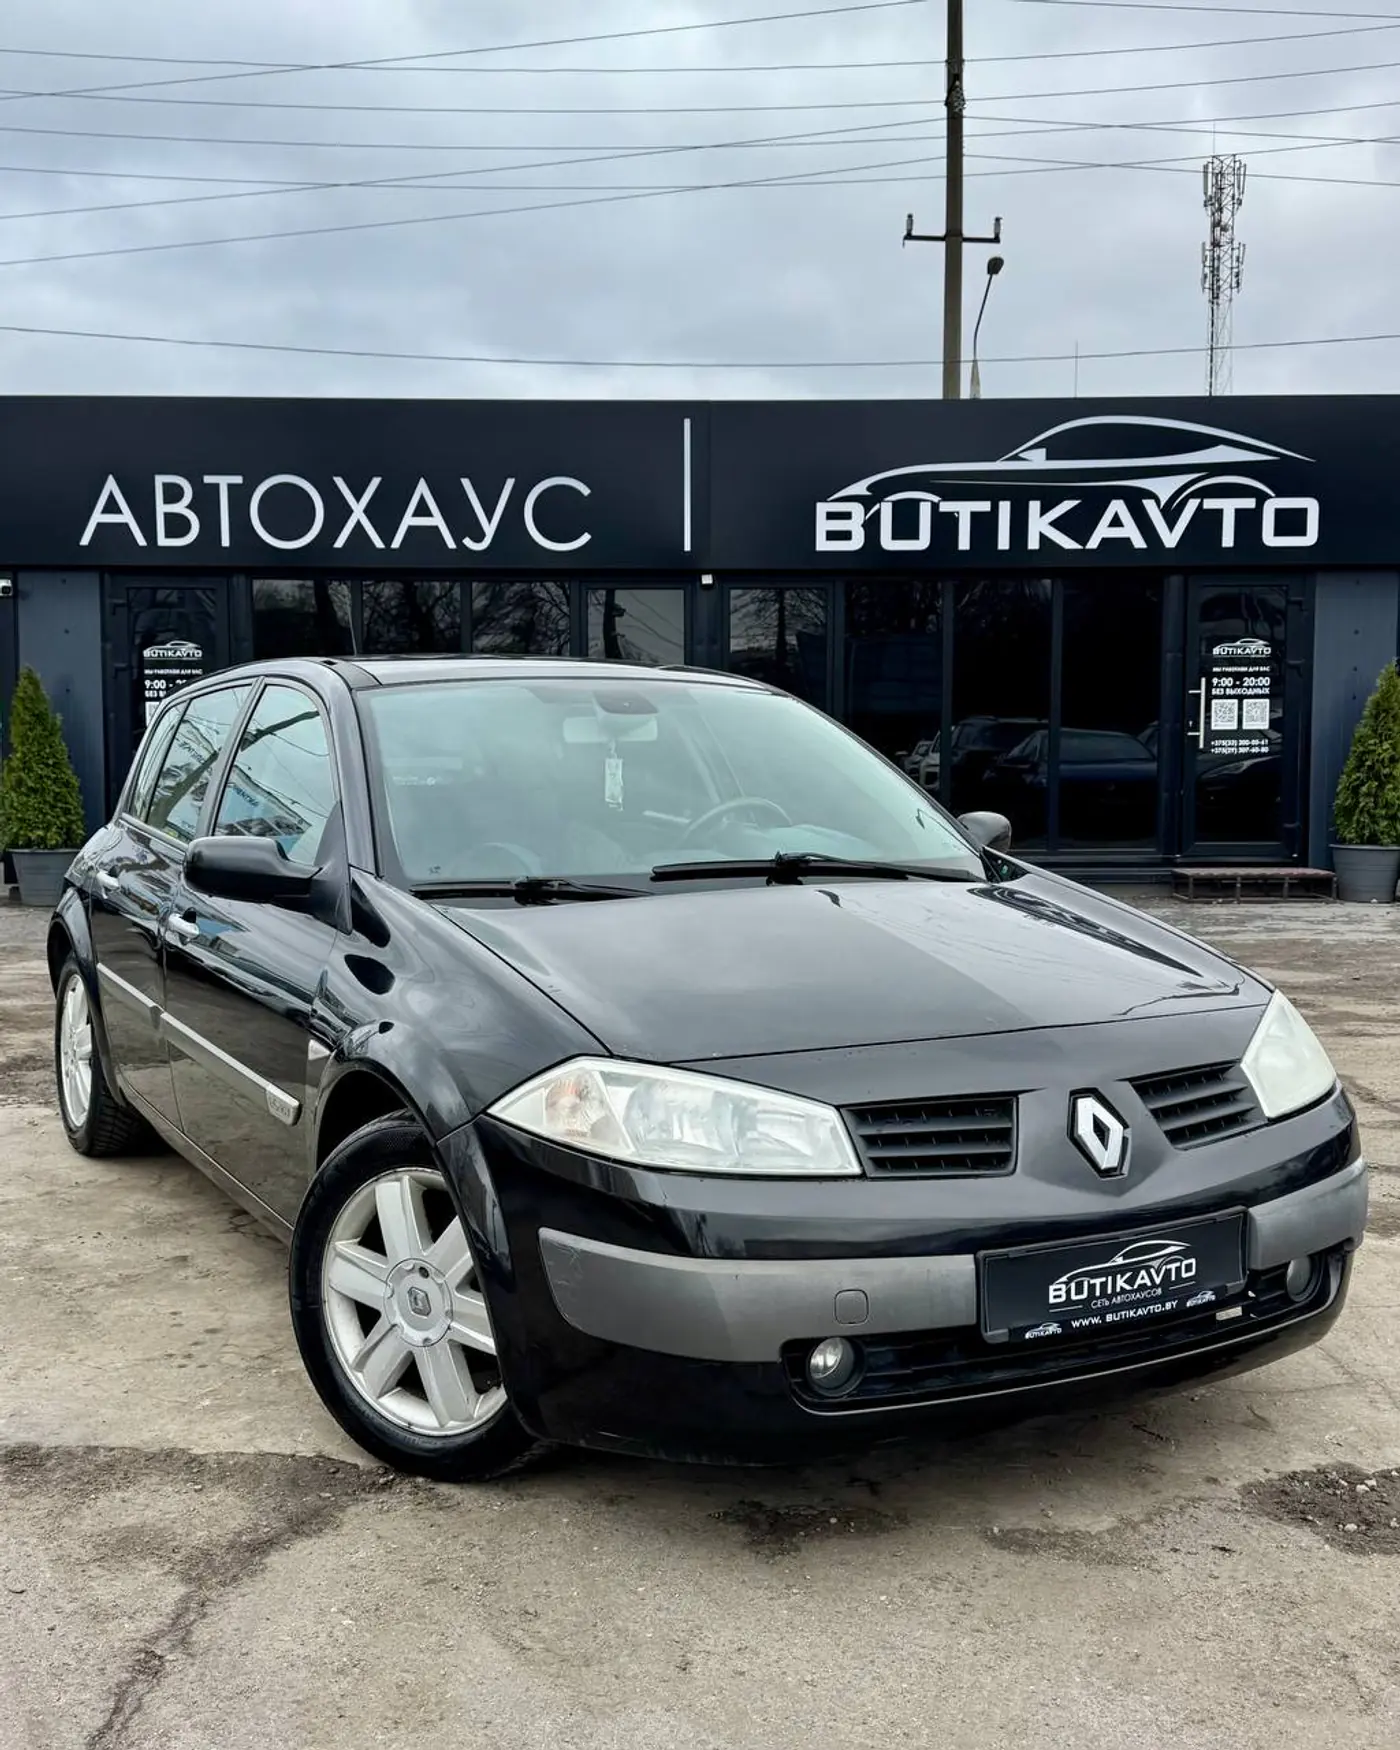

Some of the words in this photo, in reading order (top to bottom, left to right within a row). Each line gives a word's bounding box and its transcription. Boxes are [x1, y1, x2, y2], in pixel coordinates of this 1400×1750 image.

[79, 474, 592, 552] АВТОХАУС
[815, 496, 1320, 552] BUTIKAVTO
[1212, 646, 1272, 655] BUTIKAVTO
[144, 679, 167, 689] 9:00
[1211, 676, 1234, 687] 9:00
[1242, 676, 1271, 687] 20:00
[1225, 687, 1270, 695] ВЫХОДНЫХ
[1049, 1258, 1196, 1304] BUTIKAVTO
[1091, 1297, 1110, 1309] СЕТЬ
[1111, 1287, 1162, 1305] АВТОХАУСОВ
[1105, 1300, 1178, 1322] BUTIKAVTO.BY
